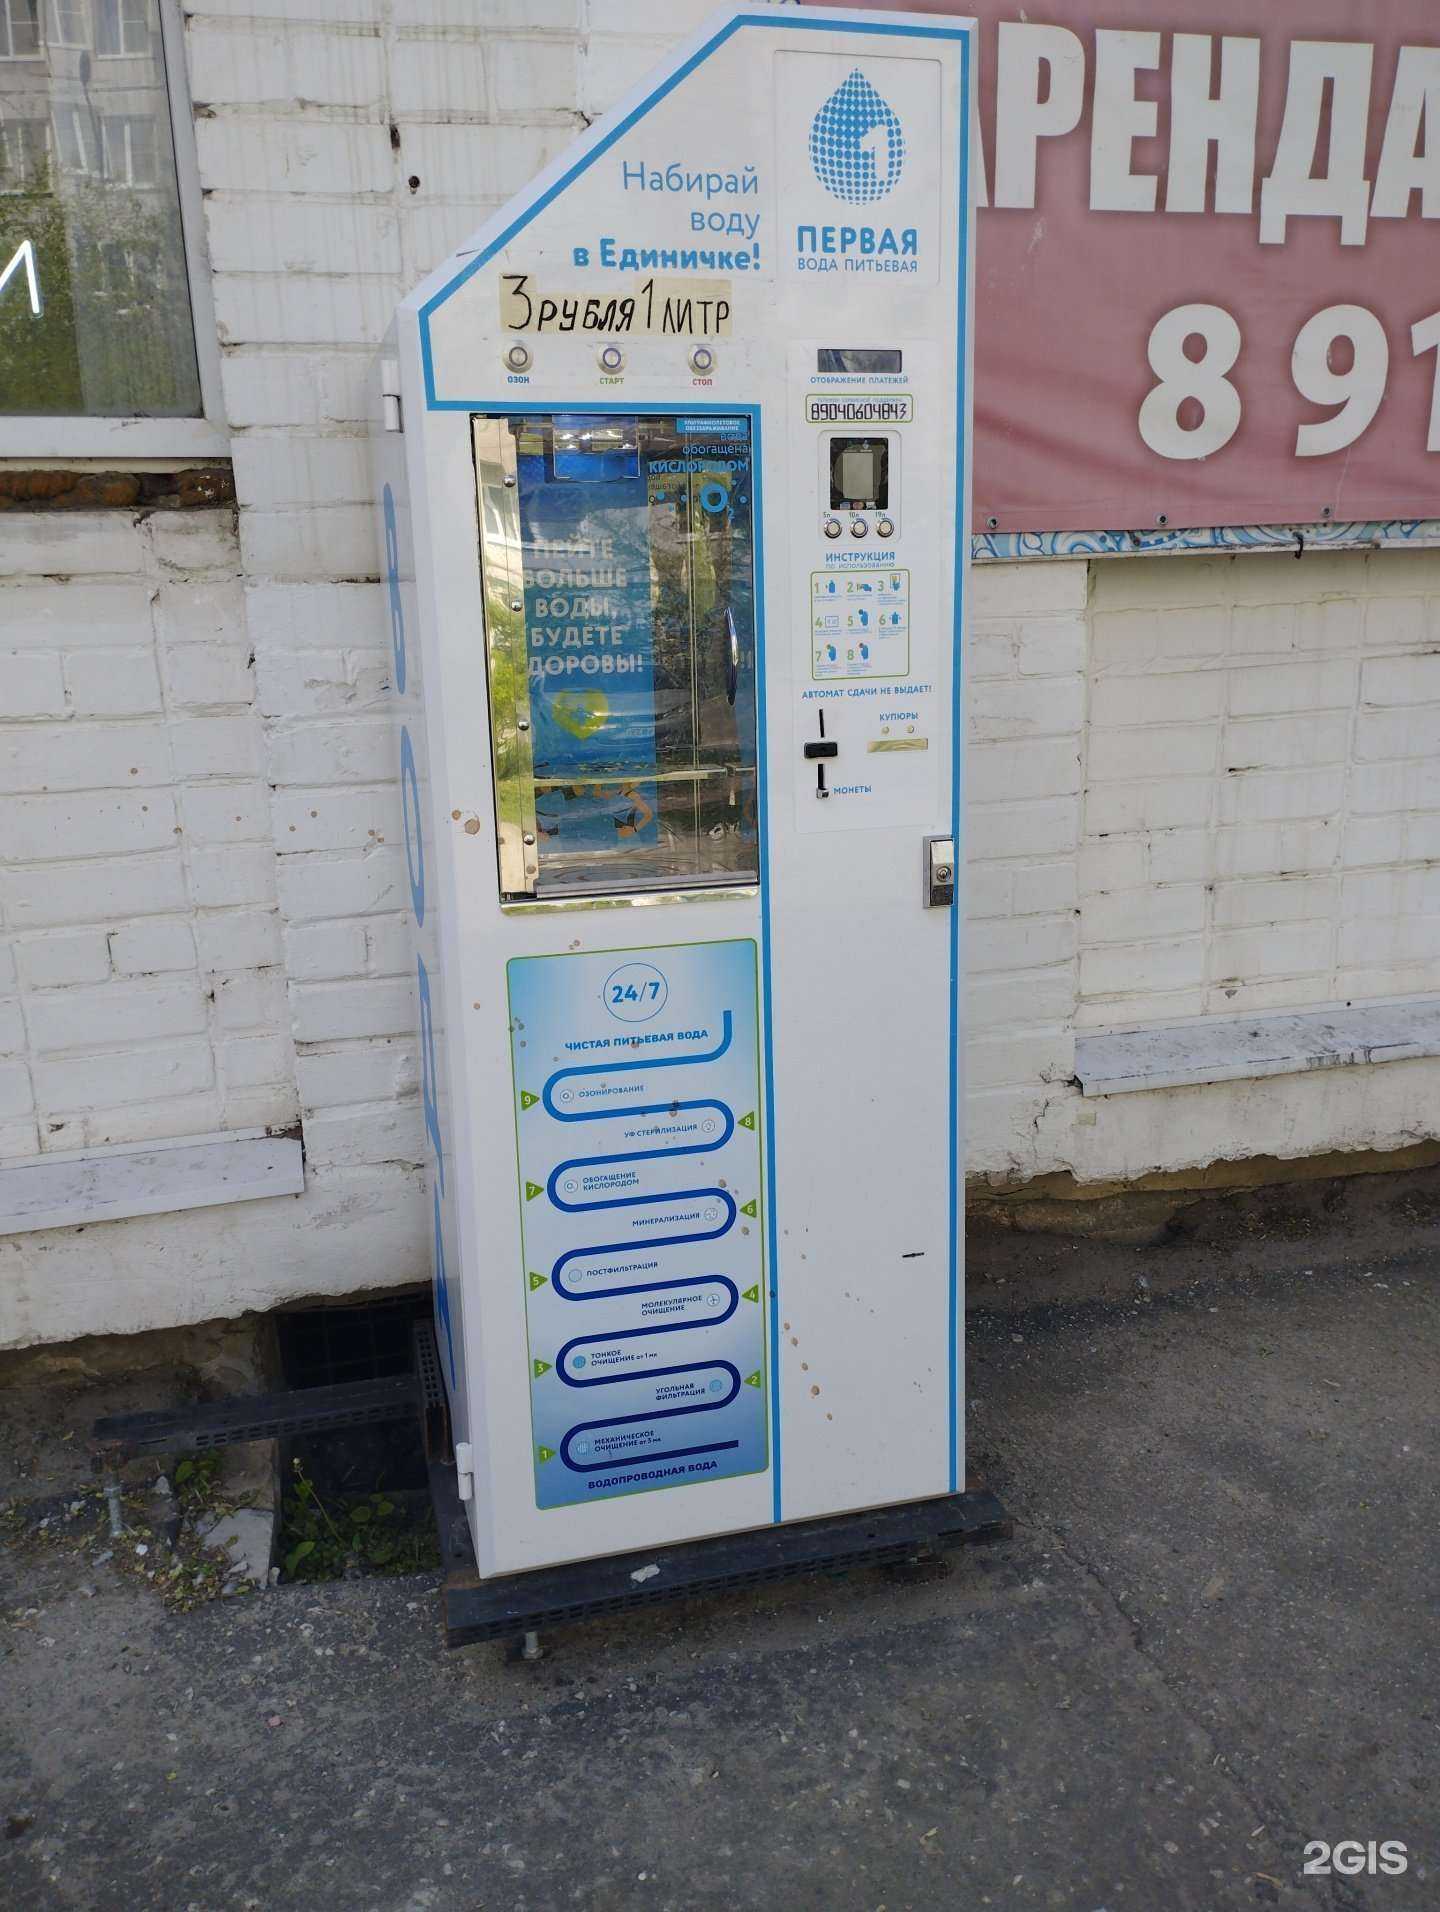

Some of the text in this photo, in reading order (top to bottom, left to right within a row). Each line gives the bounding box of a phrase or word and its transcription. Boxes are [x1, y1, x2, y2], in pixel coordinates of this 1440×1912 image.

[972, 20, 1440, 247] РЕНДА
[622, 160, 760, 200] Набирай
[690, 211, 761, 240] воду
[797, 225, 918, 255] ПЕРВАЯ
[572, 237, 761, 271] в Единичке!
[797, 256, 918, 273] ВОДА ПИТЬЕВАЯ
[502, 274, 532, 331] 3
[640, 278, 654, 330] 1
[507, 375, 530, 384] ОЗОН
[599, 376, 625, 386] СТАРТ
[692, 378, 713, 387] СТОП
[810, 375, 908, 385] ОТОБРАЖЕНИЕ ПЛАТЕЖЕЙ
[825, 551, 895, 562] ИНСТРУКЦИЯ
[535, 597, 618, 620] ВОДЫ,
[530, 624, 623, 649] БУДЕТЕ
[528, 653, 644, 676] ДОРОВЫ!
[802, 685, 932, 699] АВТОМАТ СДАЧИ НЕ ВЫДАЕТ!
[879, 712, 918, 721] КУПЮРЫ
[833, 786, 872, 795] МОНЕТЫ
[611, 982, 660, 1003] 24/7
[565, 1029, 708, 1051] ЧИСТАЯ ПИТЬЕВАЯ ВОДА
[578, 1084, 645, 1098] ОЗОНИРОВАНИЕ
[524, 1096, 531, 1105] 9
[744, 1118, 751, 1127] 8
[636, 1123, 698, 1137] СТЕРИЛИЗАЦИЯ
[582, 1171, 636, 1184] ОБОГАЩЕНИЕ
[528, 1186, 535, 1195] 7
[583, 1178, 640, 1191] КИСЛОРОДОМ
[632, 1212, 700, 1227] МИНЕРАЛИЗАЦИЯ
[586, 1261, 659, 1277] ПОСТФИЛЬТРАЦИЯ
[533, 1276, 539, 1286] 5
[641, 1295, 703, 1310] МОЛЕКУЛЯРНОЕ
[641, 1304, 686, 1316] ОЧИЩЕНИЕ
[591, 1349, 622, 1360] ТОНКОЕ
[591, 1355, 635, 1367] ОЧИЩЕНИЕ
[537, 1363, 543, 1373] 3
[751, 1375, 758, 1384] 2
[655, 1383, 695, 1395] УГОЛЬНАЯ
[656, 1388, 706, 1401] ФИЛЬТРАЦИЯ
[594, 1430, 655, 1445] МЕХАНИЧЕСКОЕ
[594, 1440, 638, 1453] ОЧИЩЕНИЕ
[588, 1460, 718, 1489] ВОДОПРОВОДНАЯ ВОДА
